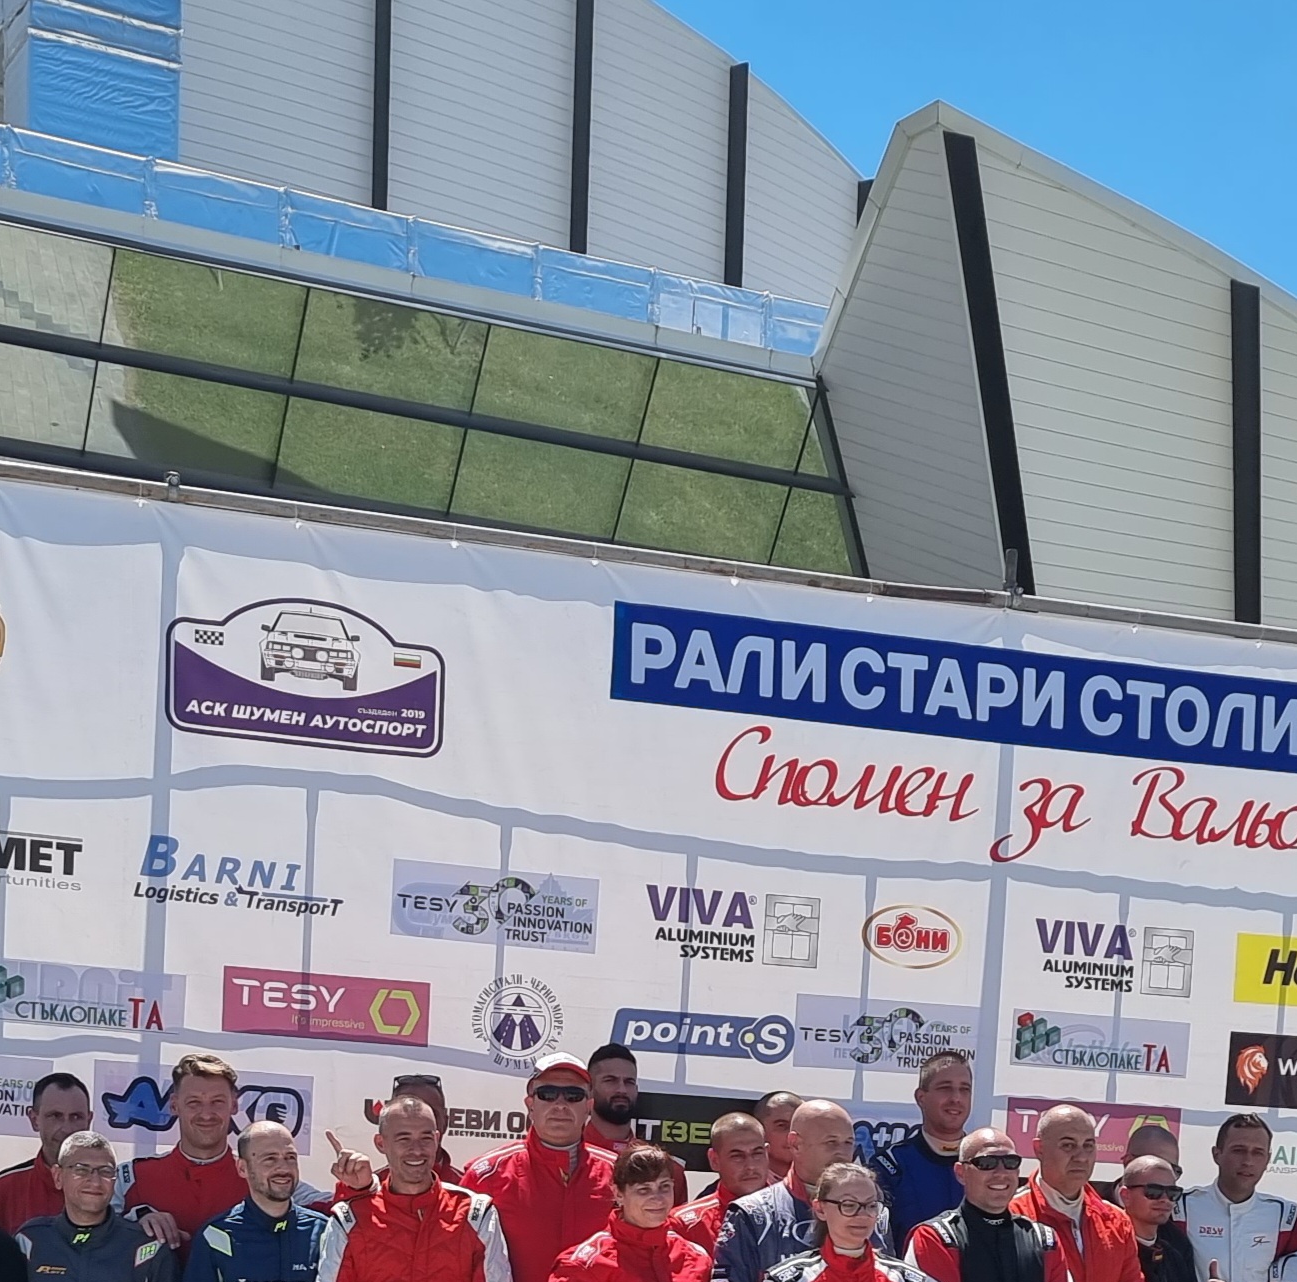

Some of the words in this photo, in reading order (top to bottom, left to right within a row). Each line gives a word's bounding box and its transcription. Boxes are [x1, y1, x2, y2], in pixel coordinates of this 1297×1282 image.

[630, 622, 826, 703] РАЛИ
[840, 653, 1064, 729] СТАРИ
[186, 698, 227, 719] АСК
[232, 704, 306, 728] ШУМЕН
[309, 713, 427, 739] АУТОСПОРТ
[401, 708, 426, 720] 2019
[715, 726, 978, 817] Спомен
[990, 777, 1090, 862] за
[140, 835, 301, 892] BARNI
[134, 882, 218, 907] Logistics
[225, 890, 239, 906] &
[397, 894, 458, 912] TESY
[541, 895, 572, 905] YEARS
[575, 898, 588, 907] OF
[507, 903, 565, 919] PASSION
[646, 883, 754, 930] VIVA
[513, 916, 593, 934] INNOVATION
[505, 928, 547, 943] TRUST
[655, 926, 755, 948] ALUMINIUM
[874, 926, 951, 953] БОНИ
[1036, 918, 1133, 960] VIVA
[679, 944, 755, 963] SYSTEMS
[1043, 958, 1134, 978] ALUMINIUM
[1065, 976, 1133, 993] SYSTEMS
[232, 978, 346, 1012] TESY
[309, 1017, 365, 1031] impressive
[622, 1018, 731, 1048] point
[930, 1023, 958, 1033] YEARS
[960, 1025, 972, 1034] OF
[799, 1026, 855, 1043] TESY
[899, 1032, 950, 1046] PASSION
